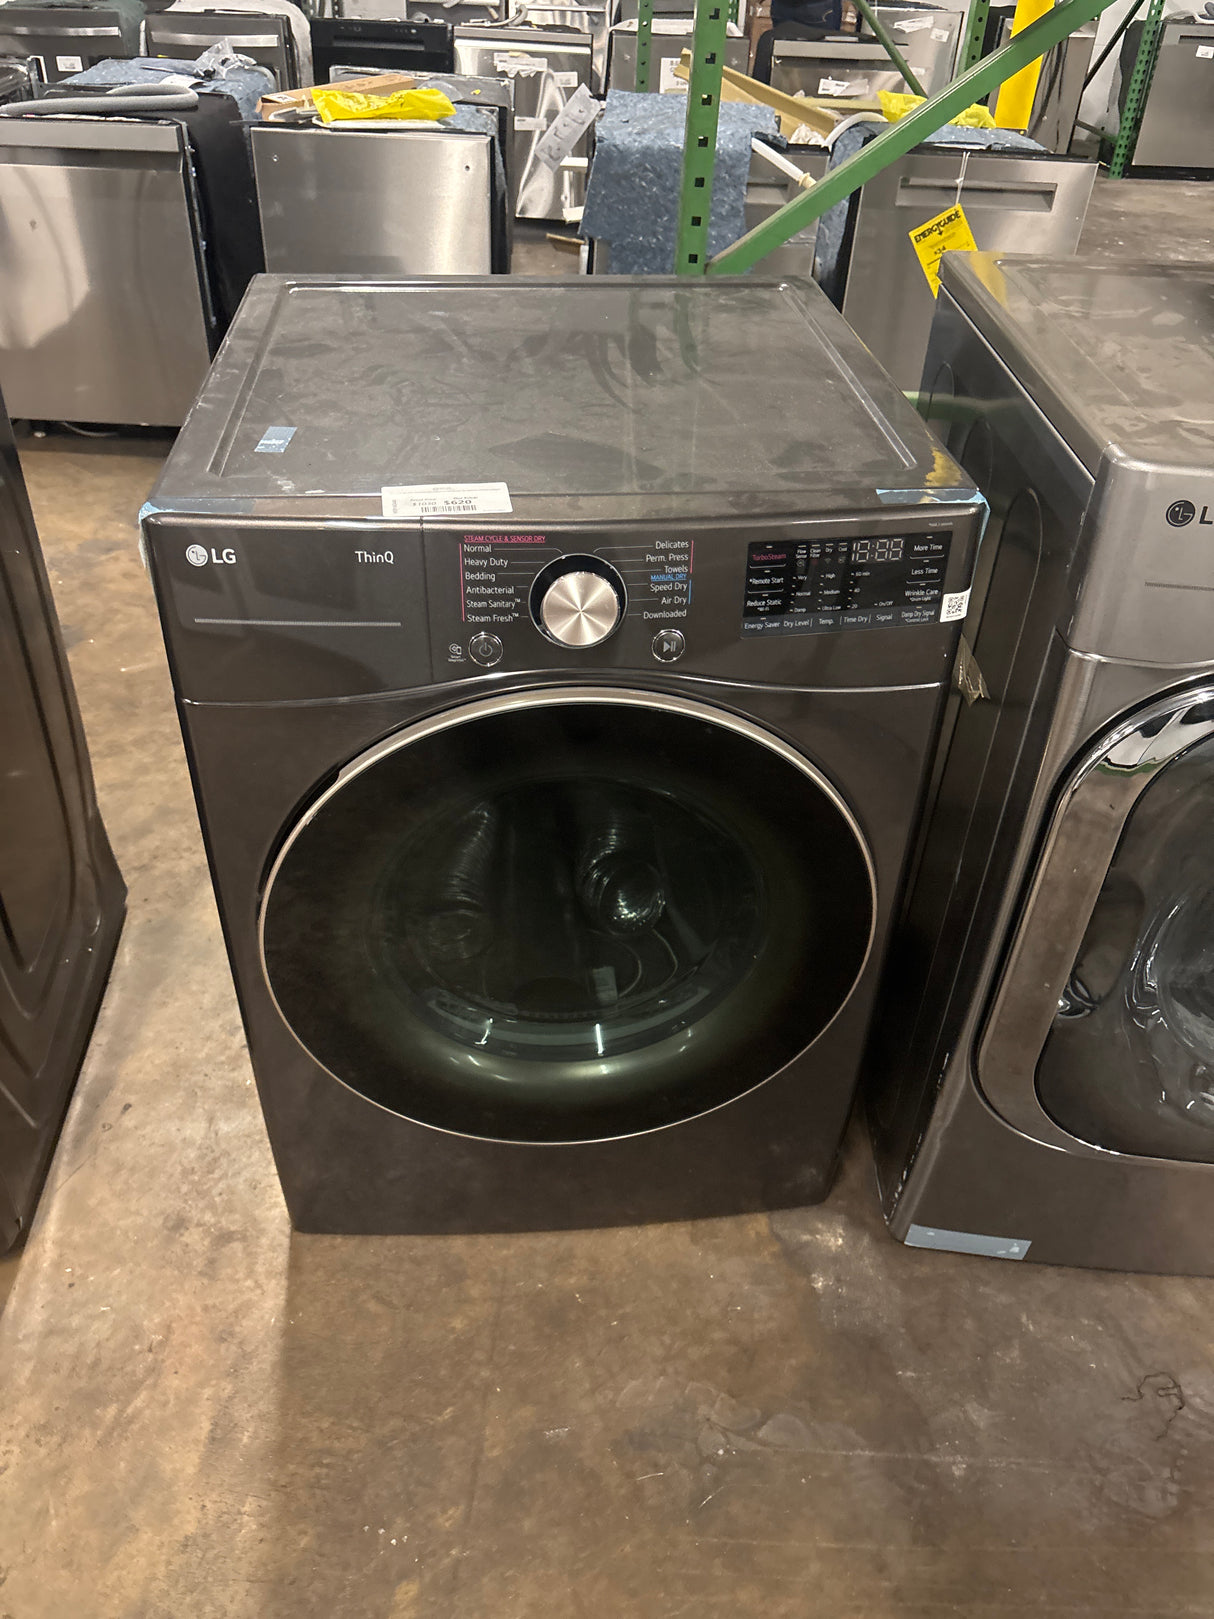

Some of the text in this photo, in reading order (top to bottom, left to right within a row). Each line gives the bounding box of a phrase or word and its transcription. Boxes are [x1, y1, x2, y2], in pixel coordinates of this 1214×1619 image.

[464, 544, 492, 552] Normal
[656, 540, 689, 550] Delicates
[211, 548, 236, 564] LG
[354, 550, 394, 564] ThinQ
[646, 554, 666, 562] Perm.
[464, 558, 508, 568] Heavy Duty
[664, 565, 688, 573] Towels
[465, 572, 496, 582] Bedding
[650, 582, 688, 593] Speed Dry
[467, 600, 487, 608] Steam
[674, 596, 687, 605] Dry
[467, 614, 491, 622] Steam
[643, 609, 686, 619] Downloaded
